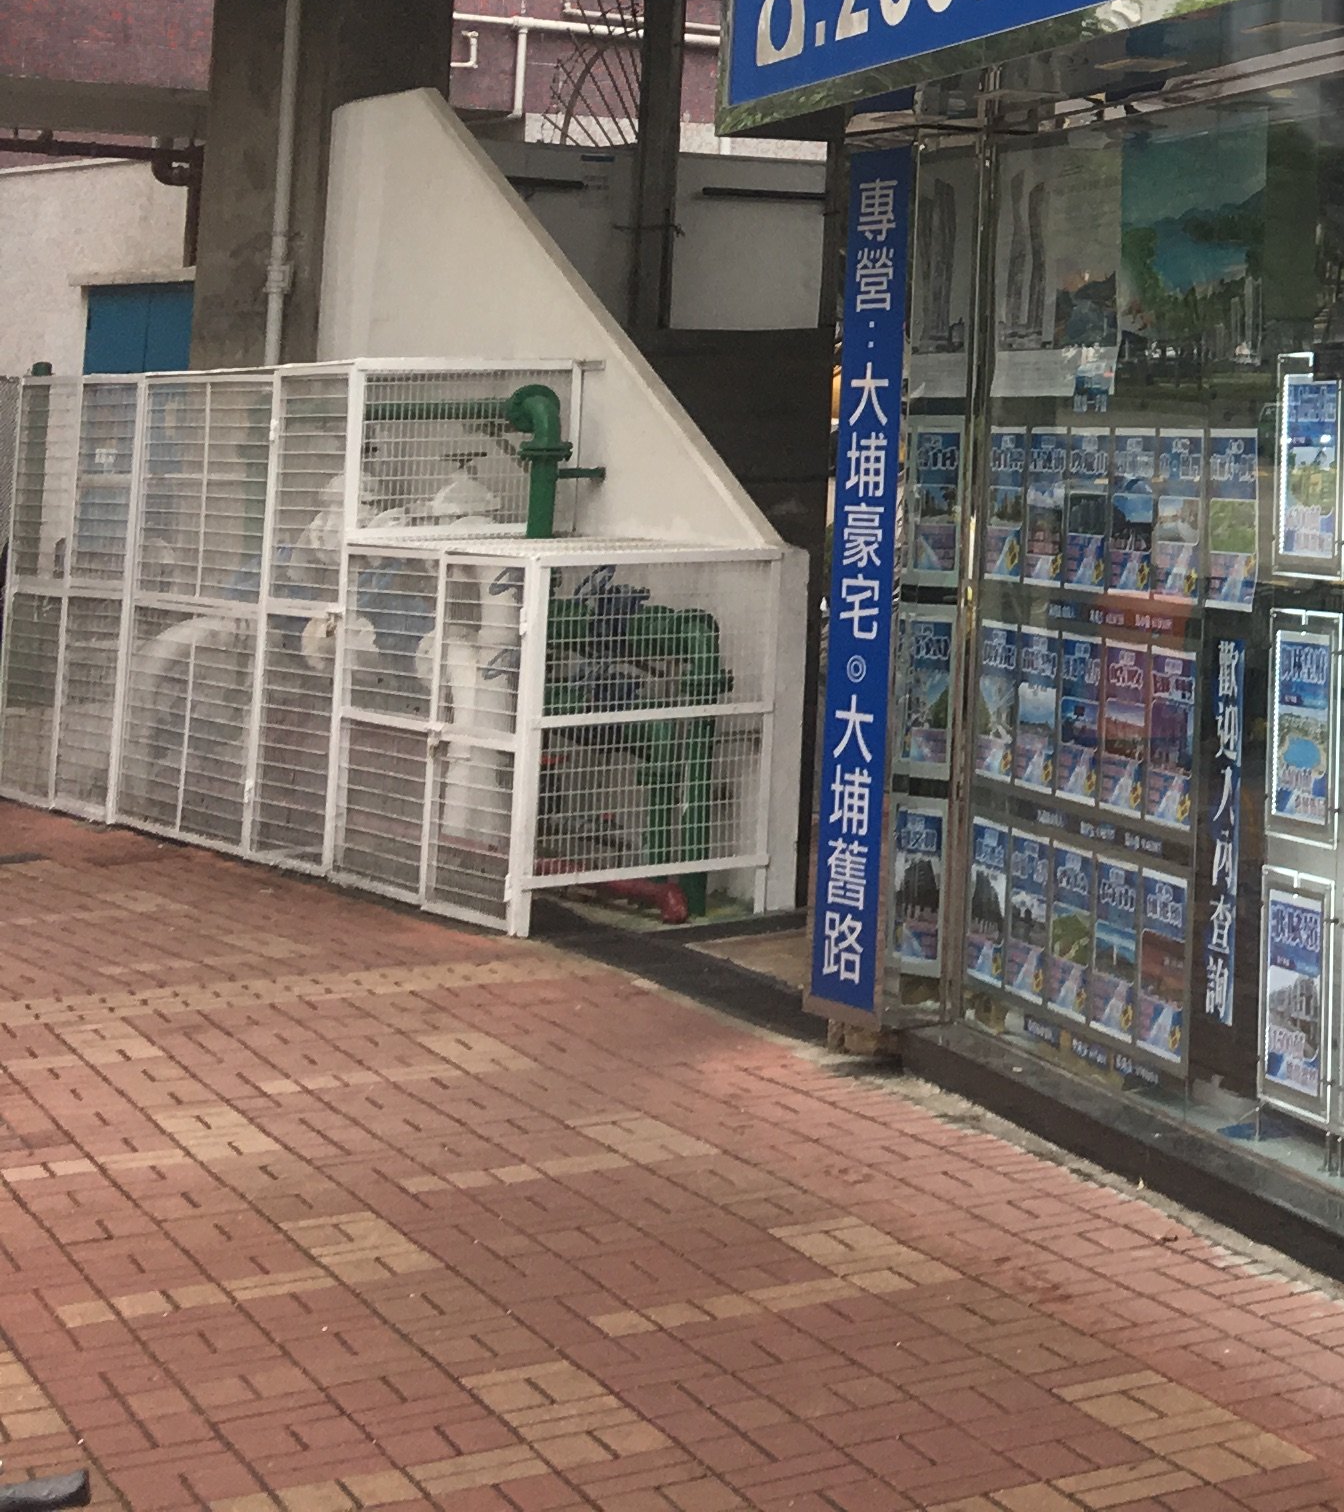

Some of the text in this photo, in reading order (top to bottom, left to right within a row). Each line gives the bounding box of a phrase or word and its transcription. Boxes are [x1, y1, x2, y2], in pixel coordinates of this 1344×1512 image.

[1205, 640, 1239, 1018] 歡迎入內查詢
